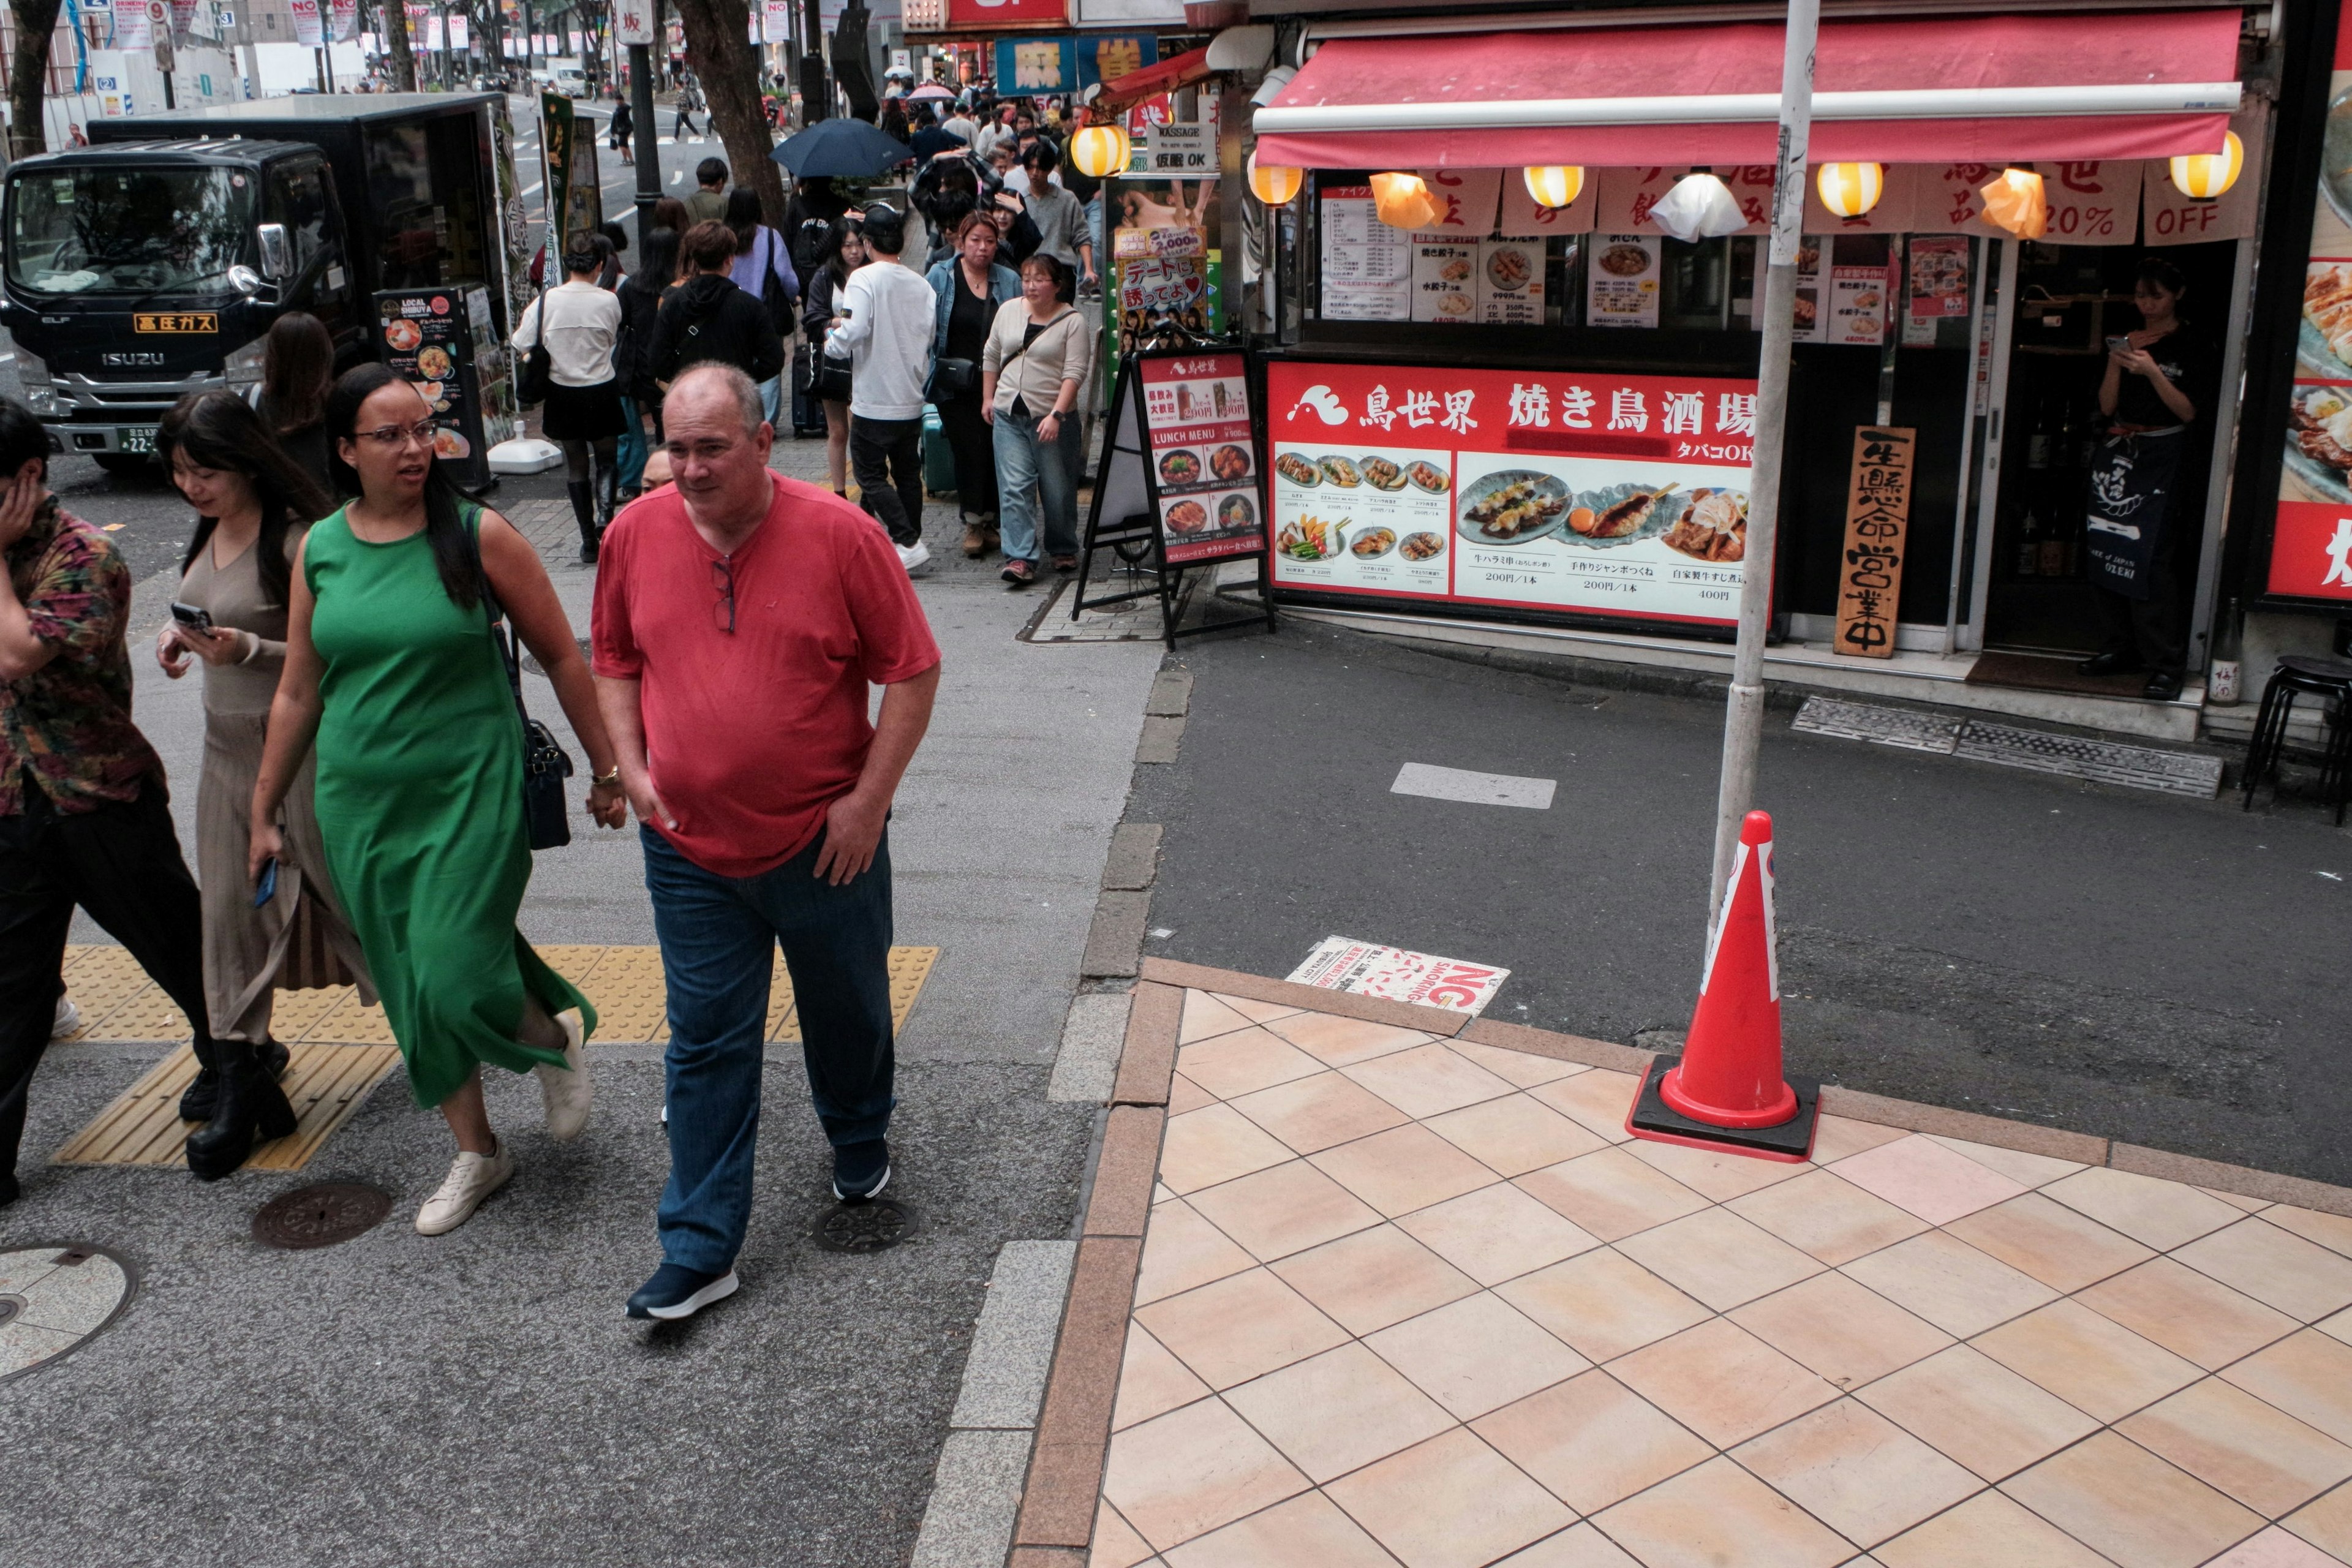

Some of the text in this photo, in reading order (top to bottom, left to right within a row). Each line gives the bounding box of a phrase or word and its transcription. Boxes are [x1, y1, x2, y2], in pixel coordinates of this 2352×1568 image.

[151, 3, 162, 18] 9
[292, 1, 315, 11] NO
[222, 14, 228, 23] 3
[624, 13, 641, 32] 坂
[1159, 128, 1200, 137] MASSAGE
[1156, 153, 1205, 167] 仮眠 OK
[2155, 205, 2219, 235] OFF
[1127, 258, 1191, 284] デートに
[401, 305, 432, 314] SHIBUYA
[138, 316, 214, 331] 高圧ガス
[102, 353, 165, 366] ISUZU
[1188, 359, 1216, 375] 鳥世界
[1148, 390, 1174, 401] 昼飲み
[1150, 403, 1175, 415] 大歓迎
[1359, 383, 1479, 435] 鳥世界
[1508, 382, 1758, 438] 焼き鳥酒場
[1154, 429, 1215, 444] LUNCH MENU
[1676, 440, 1755, 462] タバコOK
[2113, 554, 2135, 567] JAPAN
[1570, 562, 1654, 576] 手作りジャンボつくね
[2105, 562, 2135, 580] OZEKI
[1485, 572, 1538, 585] 200円/1本
[1583, 580, 1637, 593] 200円/1本
[1698, 589, 1730, 601] 400円
[1310, 951, 1334, 969] SHIBUYA
[1300, 969, 1315, 978] CITY
[1407, 961, 1452, 1001] SMOKING
